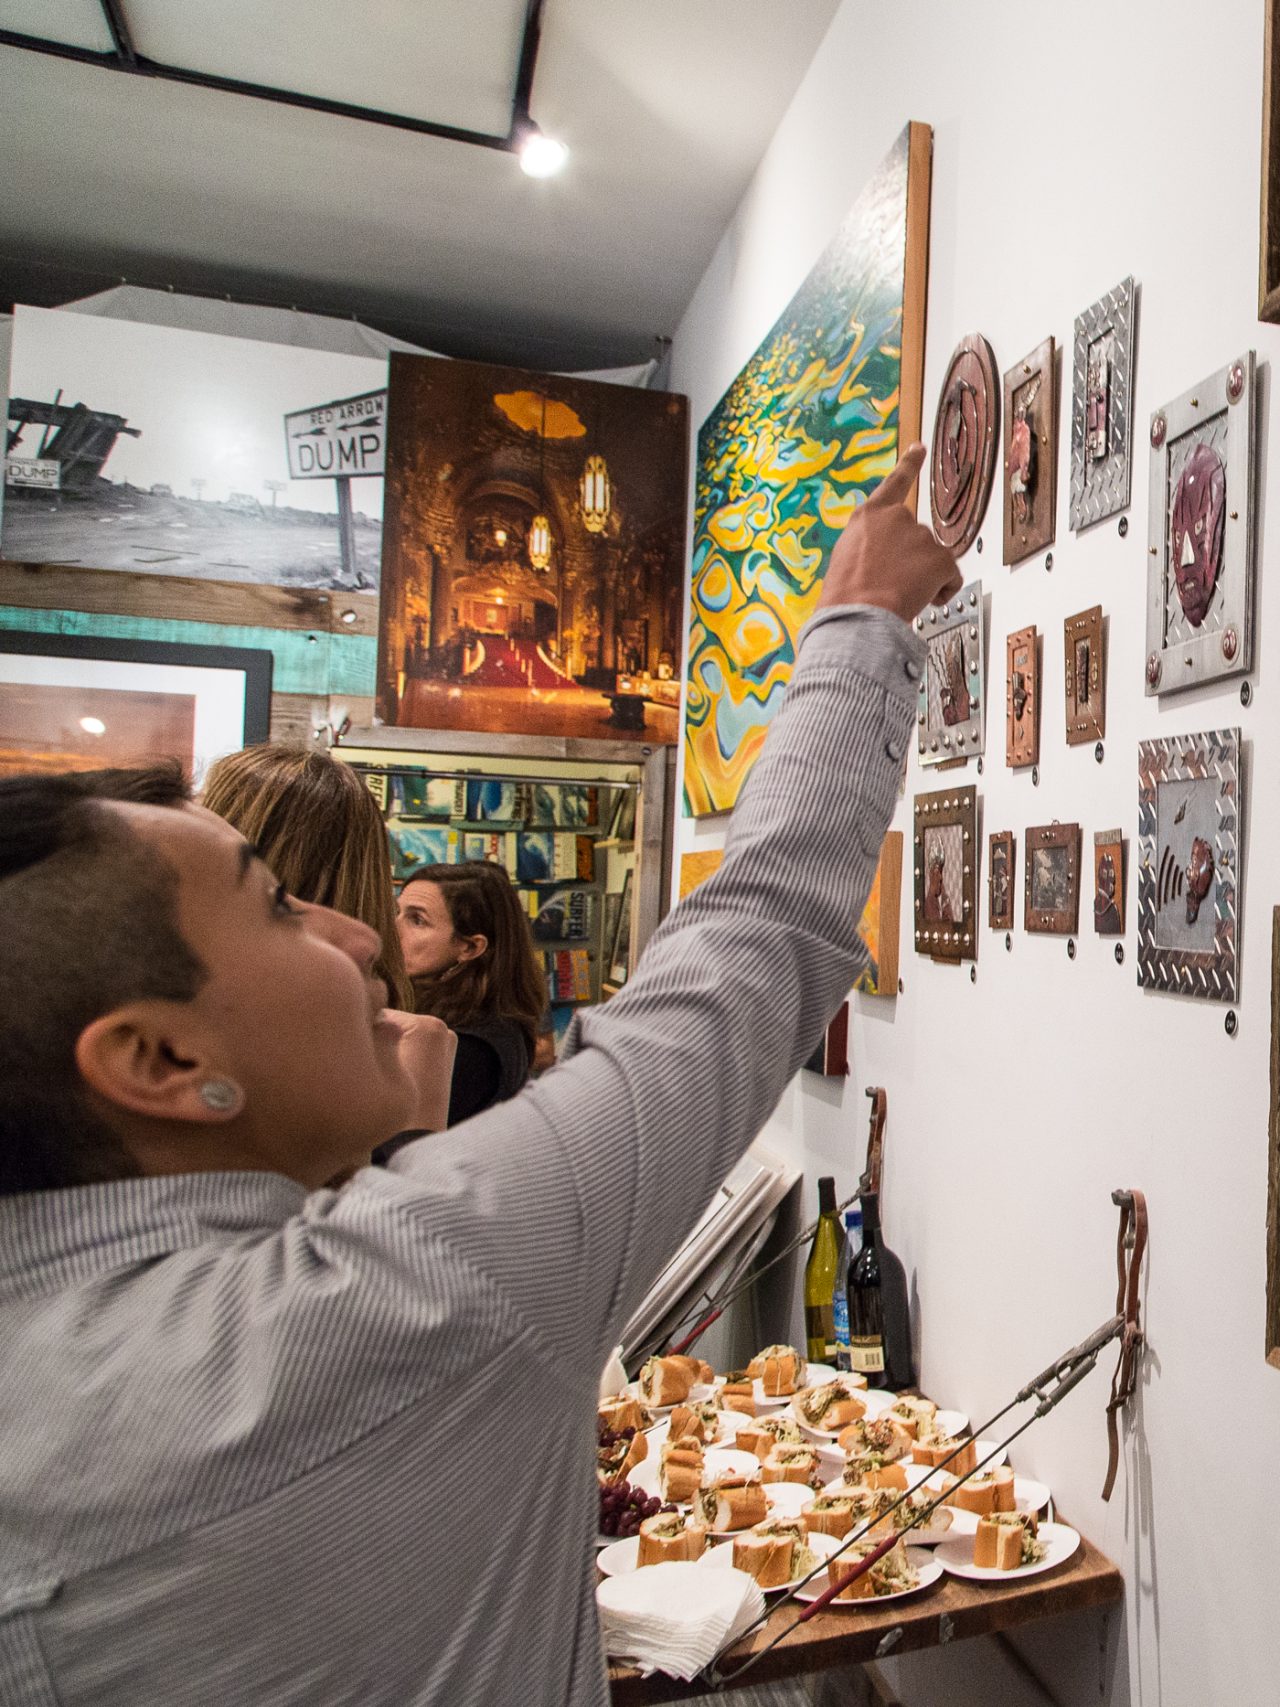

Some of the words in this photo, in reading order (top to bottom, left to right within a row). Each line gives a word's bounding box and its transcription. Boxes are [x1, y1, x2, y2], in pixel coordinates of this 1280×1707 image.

[310, 409, 334, 425] RED
[340, 396, 384, 419] ARROW
[298, 433, 381, 472] DUMP
[9, 464, 58, 479] DUMP
[570, 891, 585, 937] SURFER
